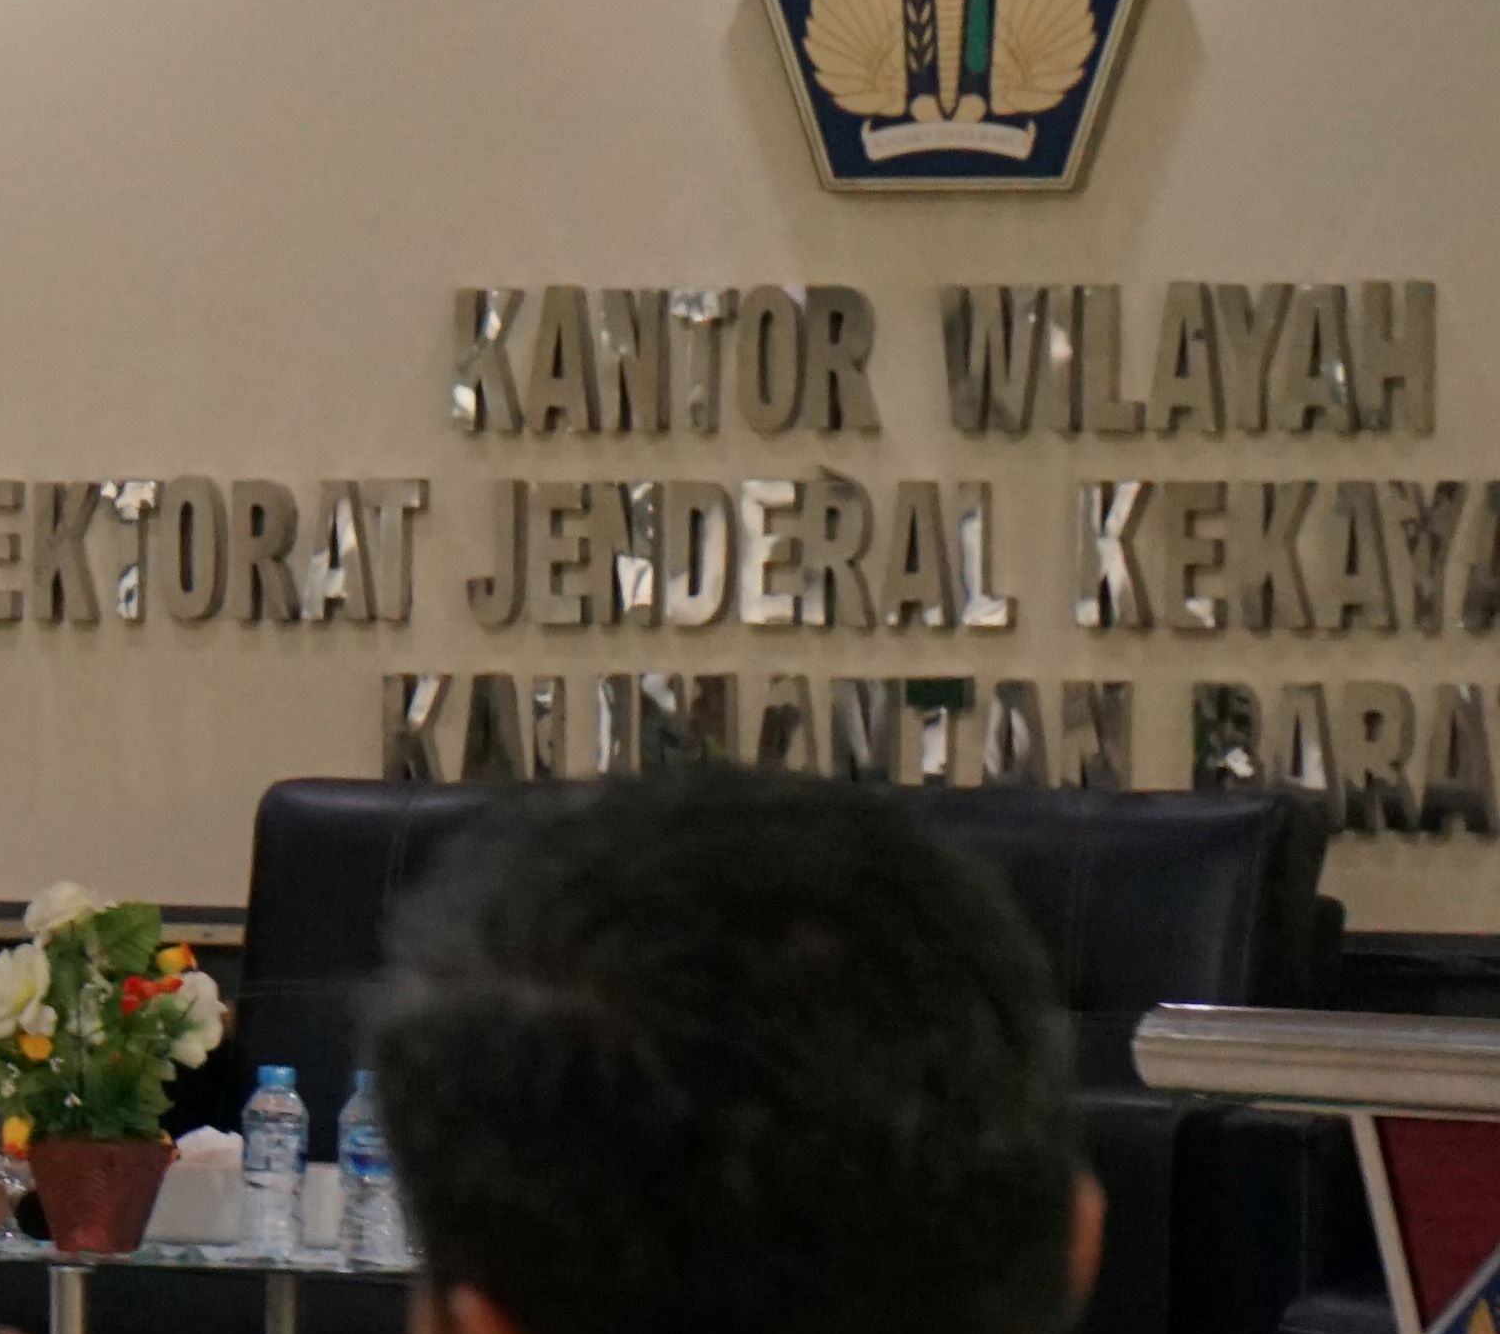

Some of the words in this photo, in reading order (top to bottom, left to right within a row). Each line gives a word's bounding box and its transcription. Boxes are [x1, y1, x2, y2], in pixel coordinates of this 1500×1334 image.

[452, 284, 883, 436] KANTOR
[941, 280, 1438, 436] WILAYAH
[466, 478, 1017, 631] JENDERAL
[1192, 678, 1500, 837] BARA
